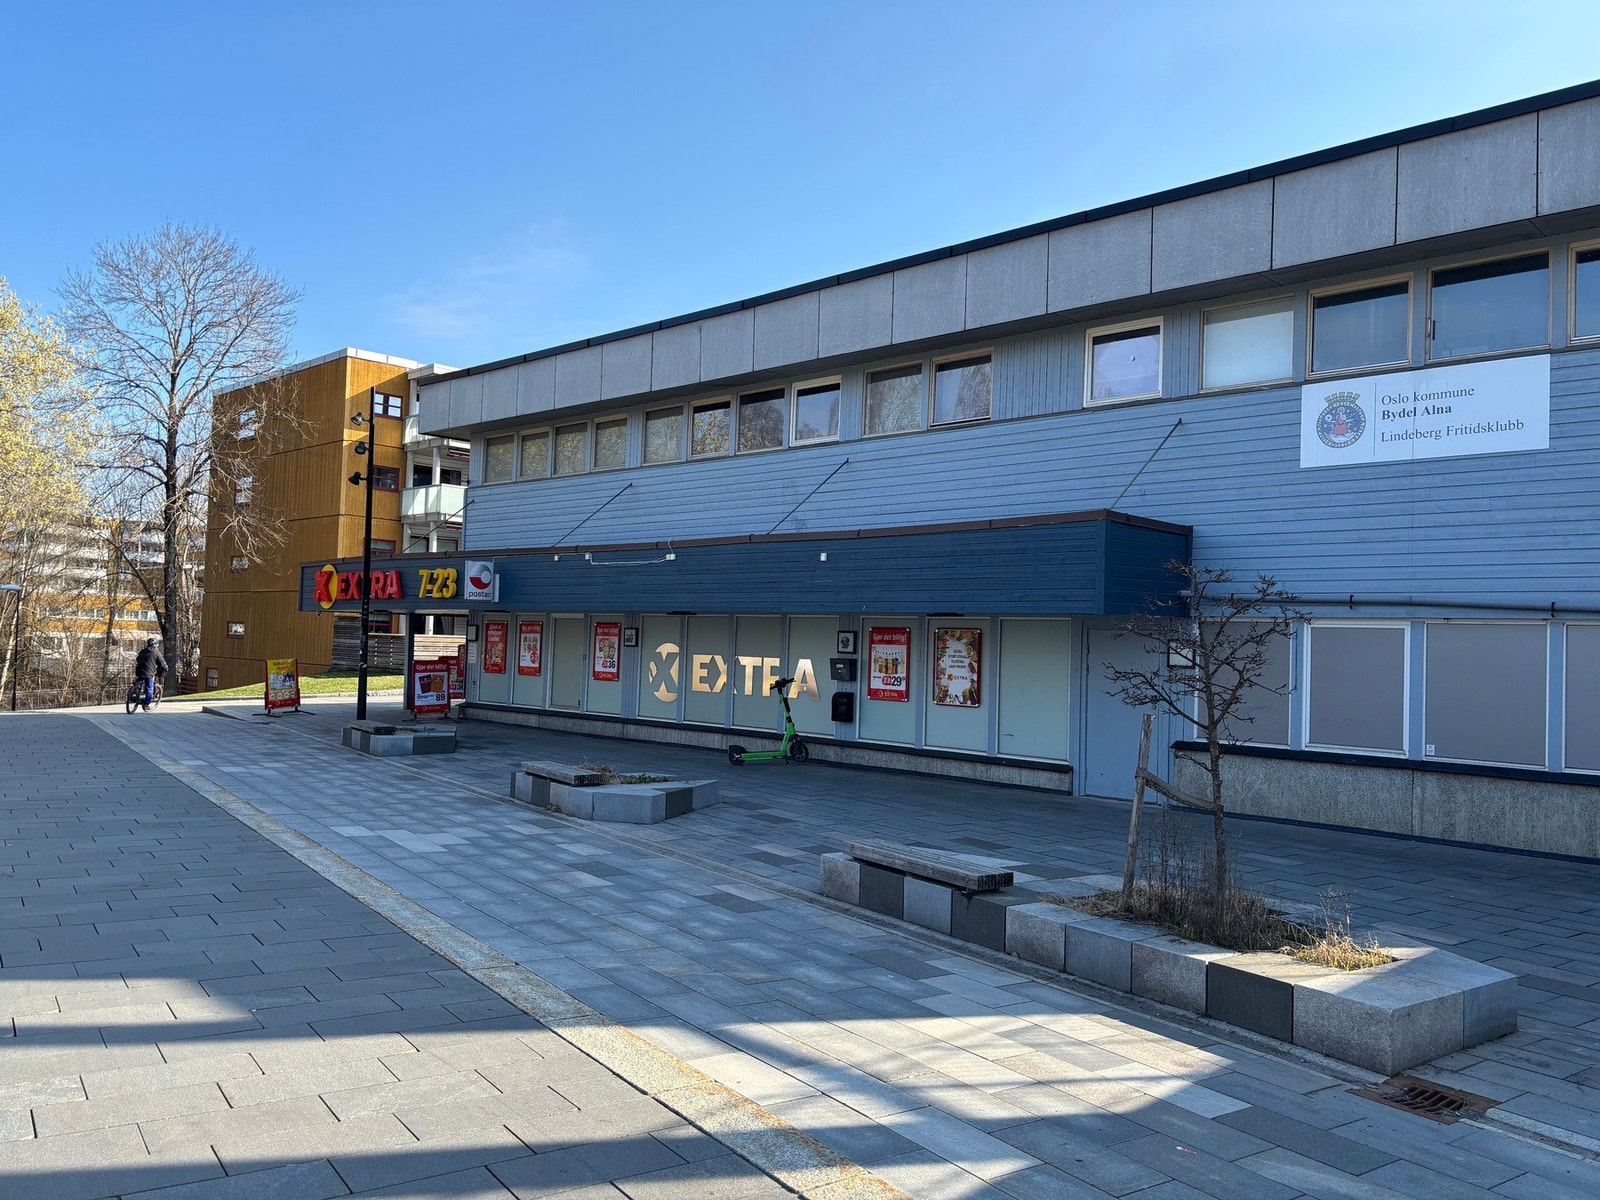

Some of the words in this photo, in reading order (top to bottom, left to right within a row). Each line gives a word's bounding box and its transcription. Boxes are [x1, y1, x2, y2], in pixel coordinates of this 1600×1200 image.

[1381, 393, 1409, 406] Oslo
[1413, 387, 1475, 403] kommune
[1381, 407, 1417, 422] Bydel
[1421, 404, 1452, 417] Alna
[1380, 428, 1442, 442] Lindeberg
[1446, 419, 1525, 437] Fritidsklubb
[418, 567, 459, 599] 7-23
[468, 590, 492, 599] posten
[608, 660, 616, 669] 36
[892, 677, 902, 688] 29
[436, 693, 446, 702] 89
